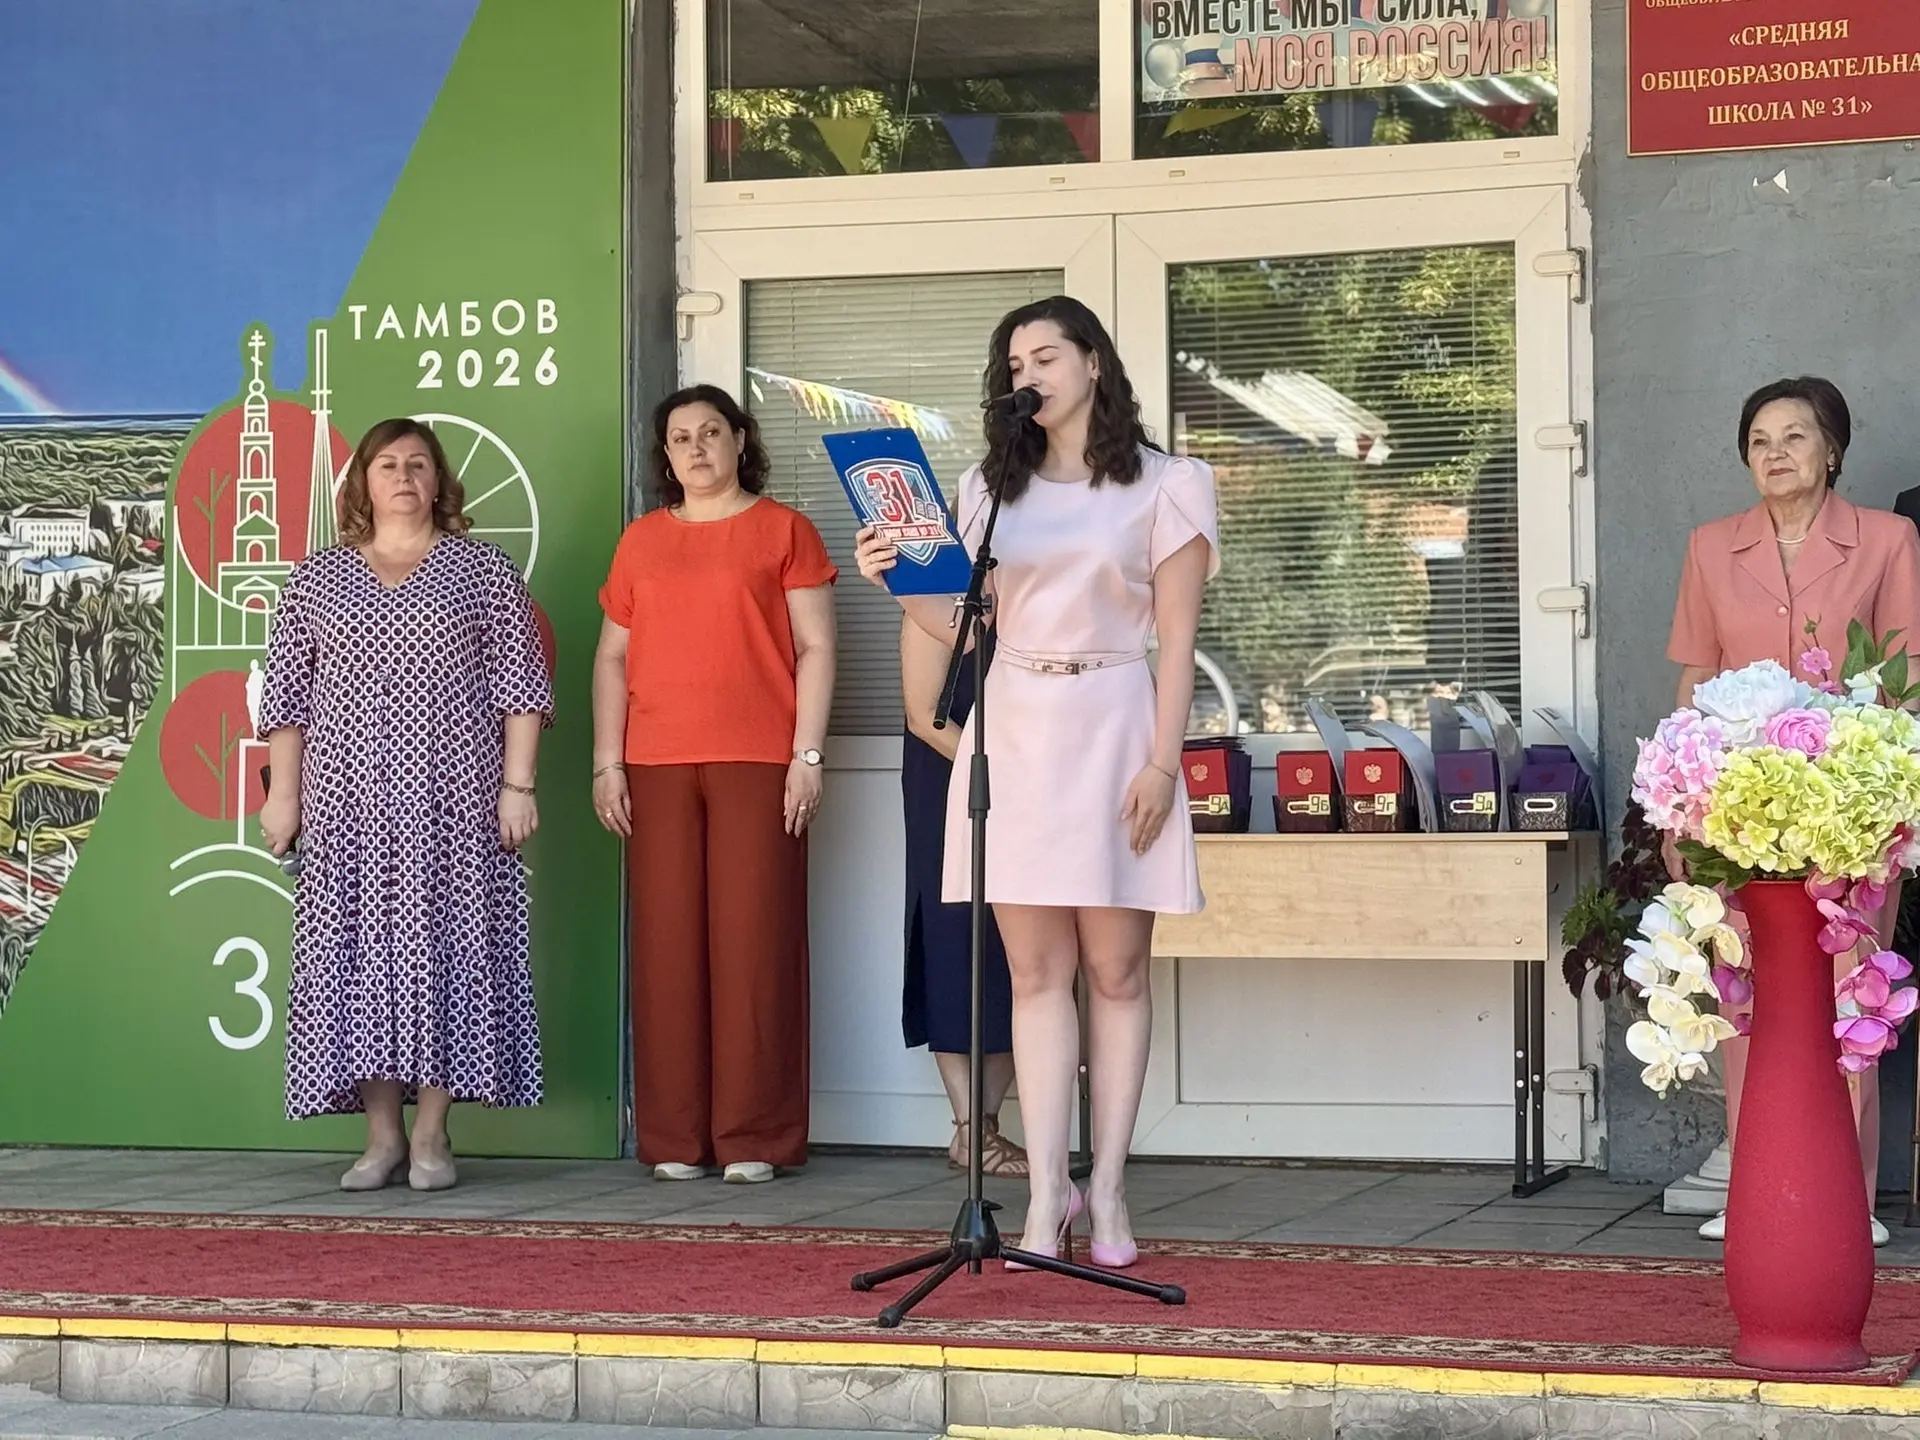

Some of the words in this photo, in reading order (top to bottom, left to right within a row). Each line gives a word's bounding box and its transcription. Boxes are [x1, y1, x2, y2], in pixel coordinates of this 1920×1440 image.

[1152, 0, 1280, 39] ВМЕСТЕ
[1291, 0, 1349, 29] МЫ
[1729, 19, 1849, 47] «СРЕДНЯЯ
[1234, 32, 1335, 93] МОЯ
[1348, 15, 1549, 86] РОССИЯ!
[1708, 101, 1795, 125] ШКОЛА
[1802, 98, 1826, 119] №
[1832, 96, 1873, 116] 31»
[348, 299, 558, 340] ТАМБОВ
[416, 346, 558, 389] 2026
[865, 468, 915, 524] 31
